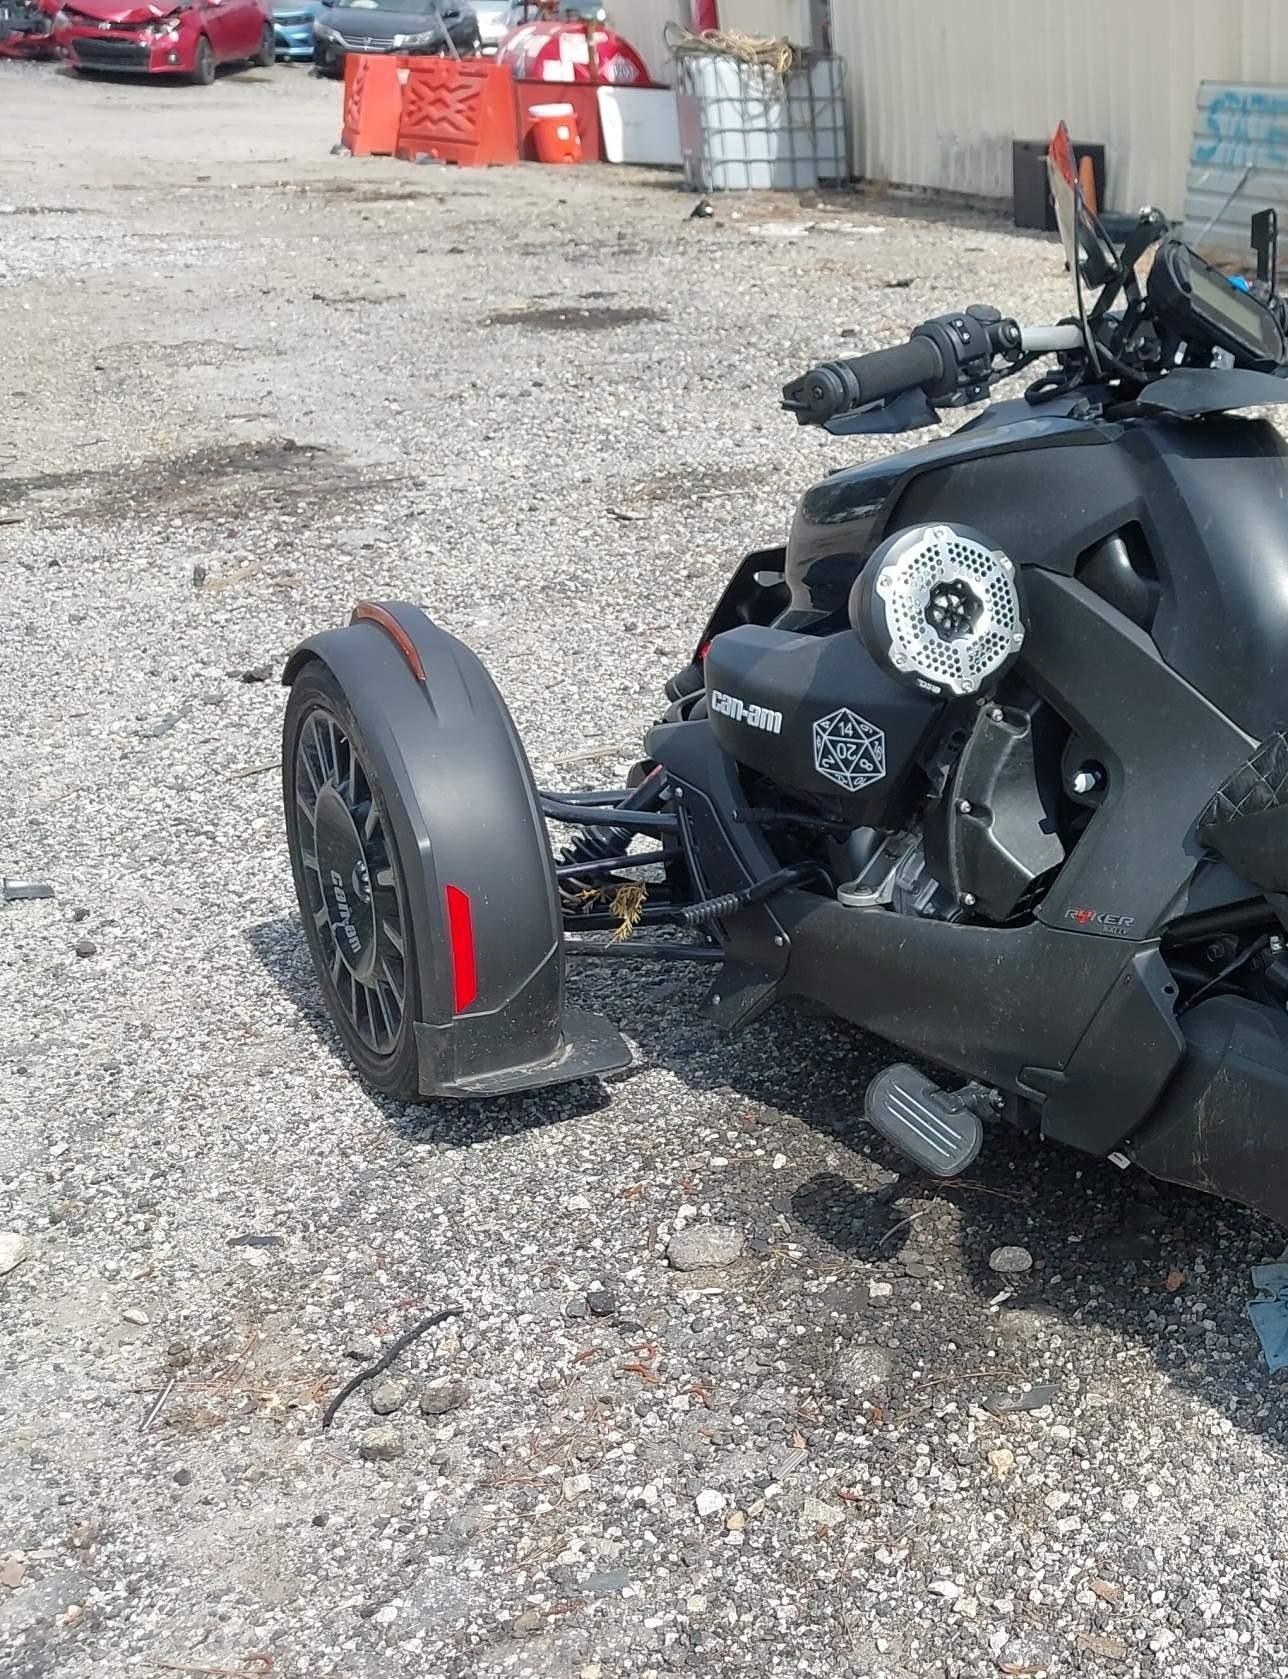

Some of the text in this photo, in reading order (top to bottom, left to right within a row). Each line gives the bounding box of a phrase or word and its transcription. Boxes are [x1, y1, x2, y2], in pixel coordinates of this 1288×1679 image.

[711, 689, 783, 735] can-am
[838, 721, 854, 737] 14
[836, 742, 857, 760] 20
[821, 755, 836, 768] 2
[859, 758, 874, 772] 8
[1102, 926, 1129, 936] RALLY
